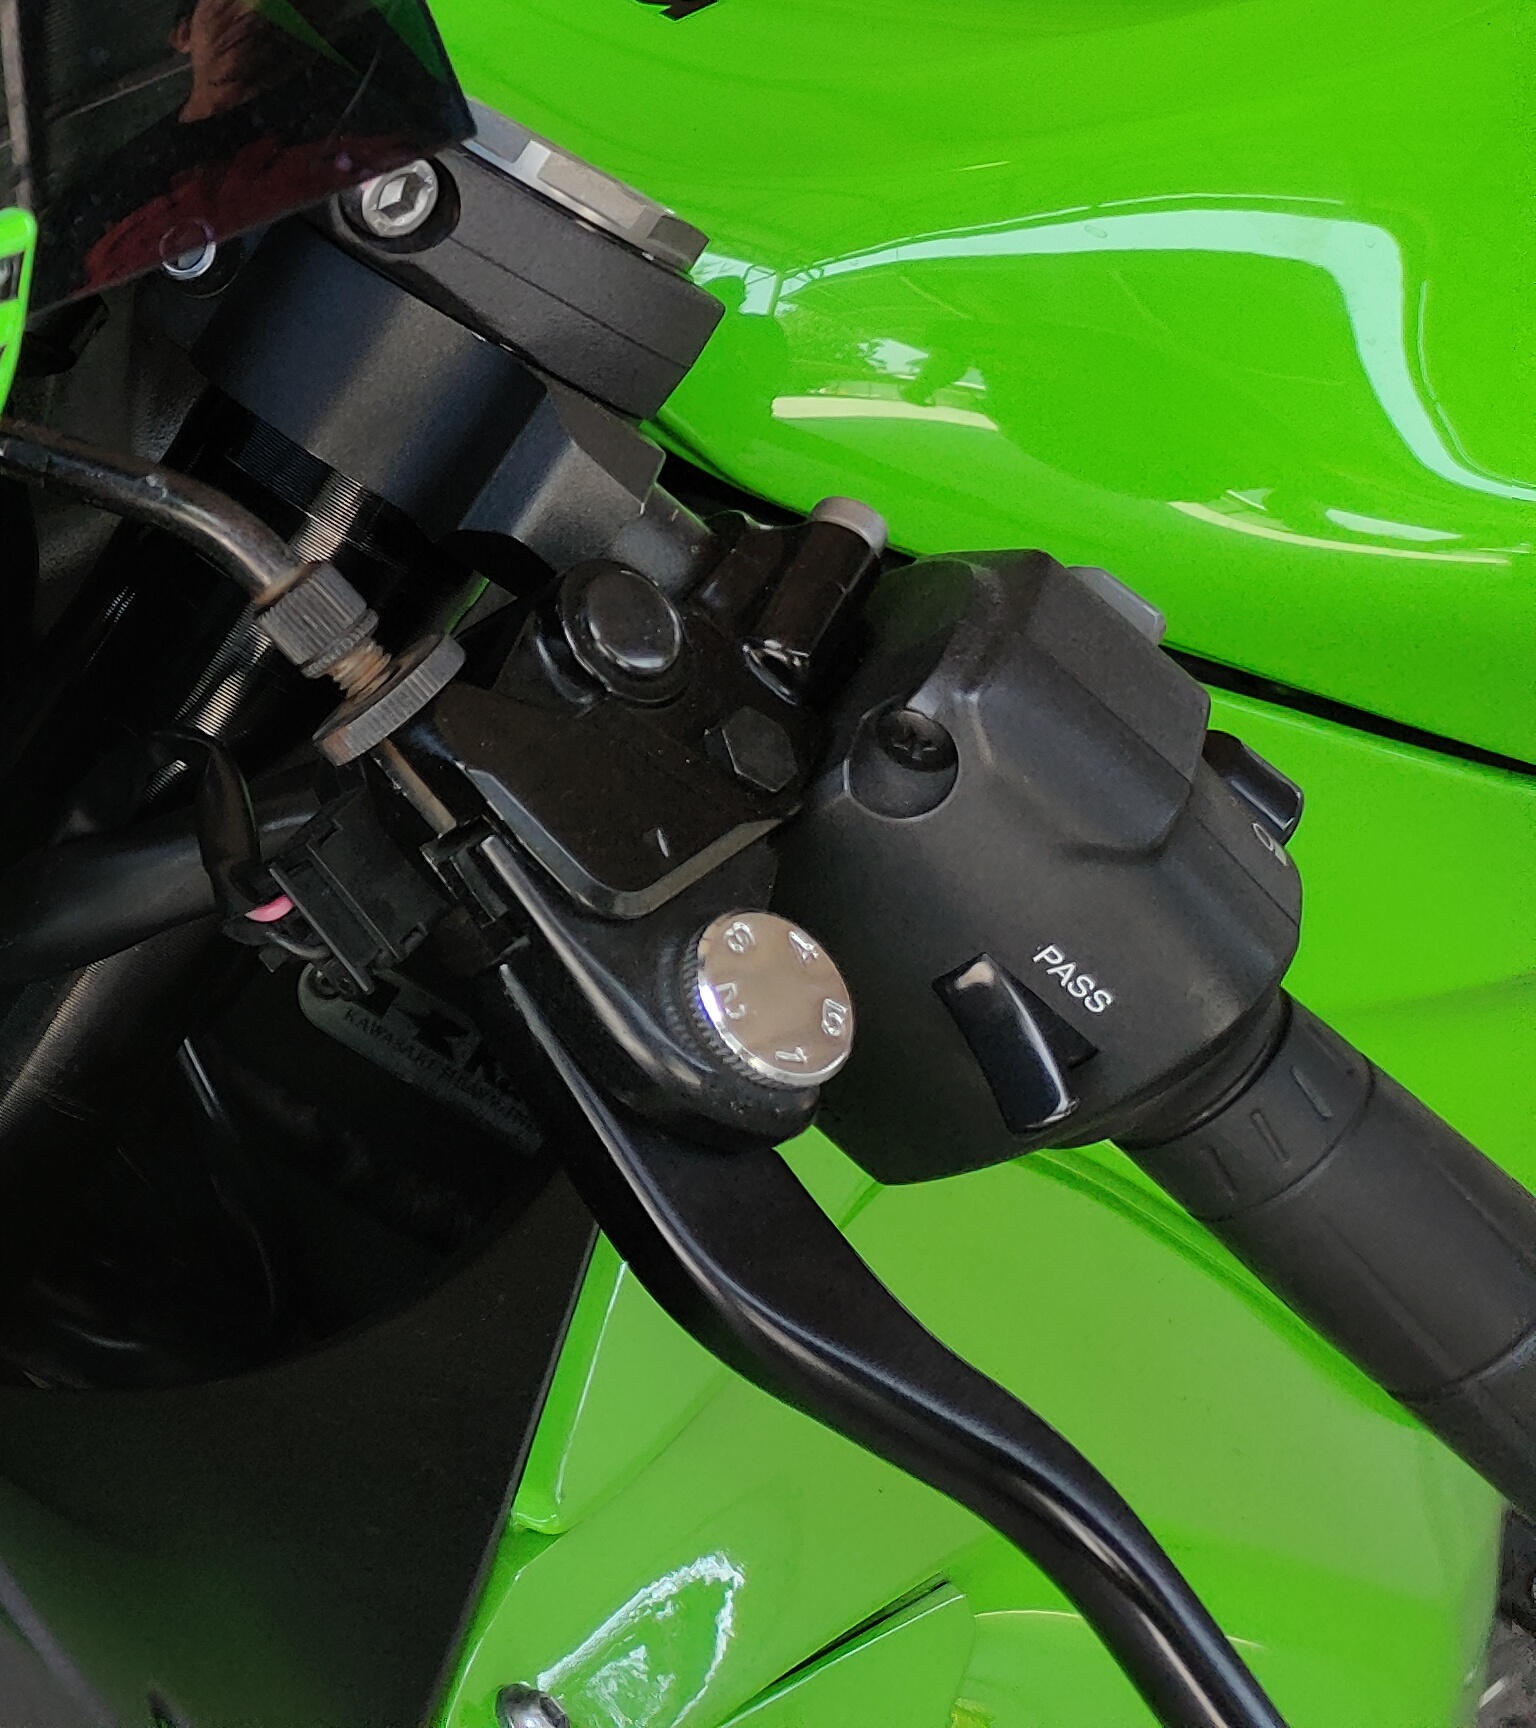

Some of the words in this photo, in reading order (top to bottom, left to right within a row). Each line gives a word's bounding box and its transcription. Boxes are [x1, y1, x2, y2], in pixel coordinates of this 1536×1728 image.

[789, 930, 820, 965] 4
[1032, 944, 1113, 1013] PASS
[821, 998, 849, 1036] 5
[774, 1046, 808, 1063] 1
